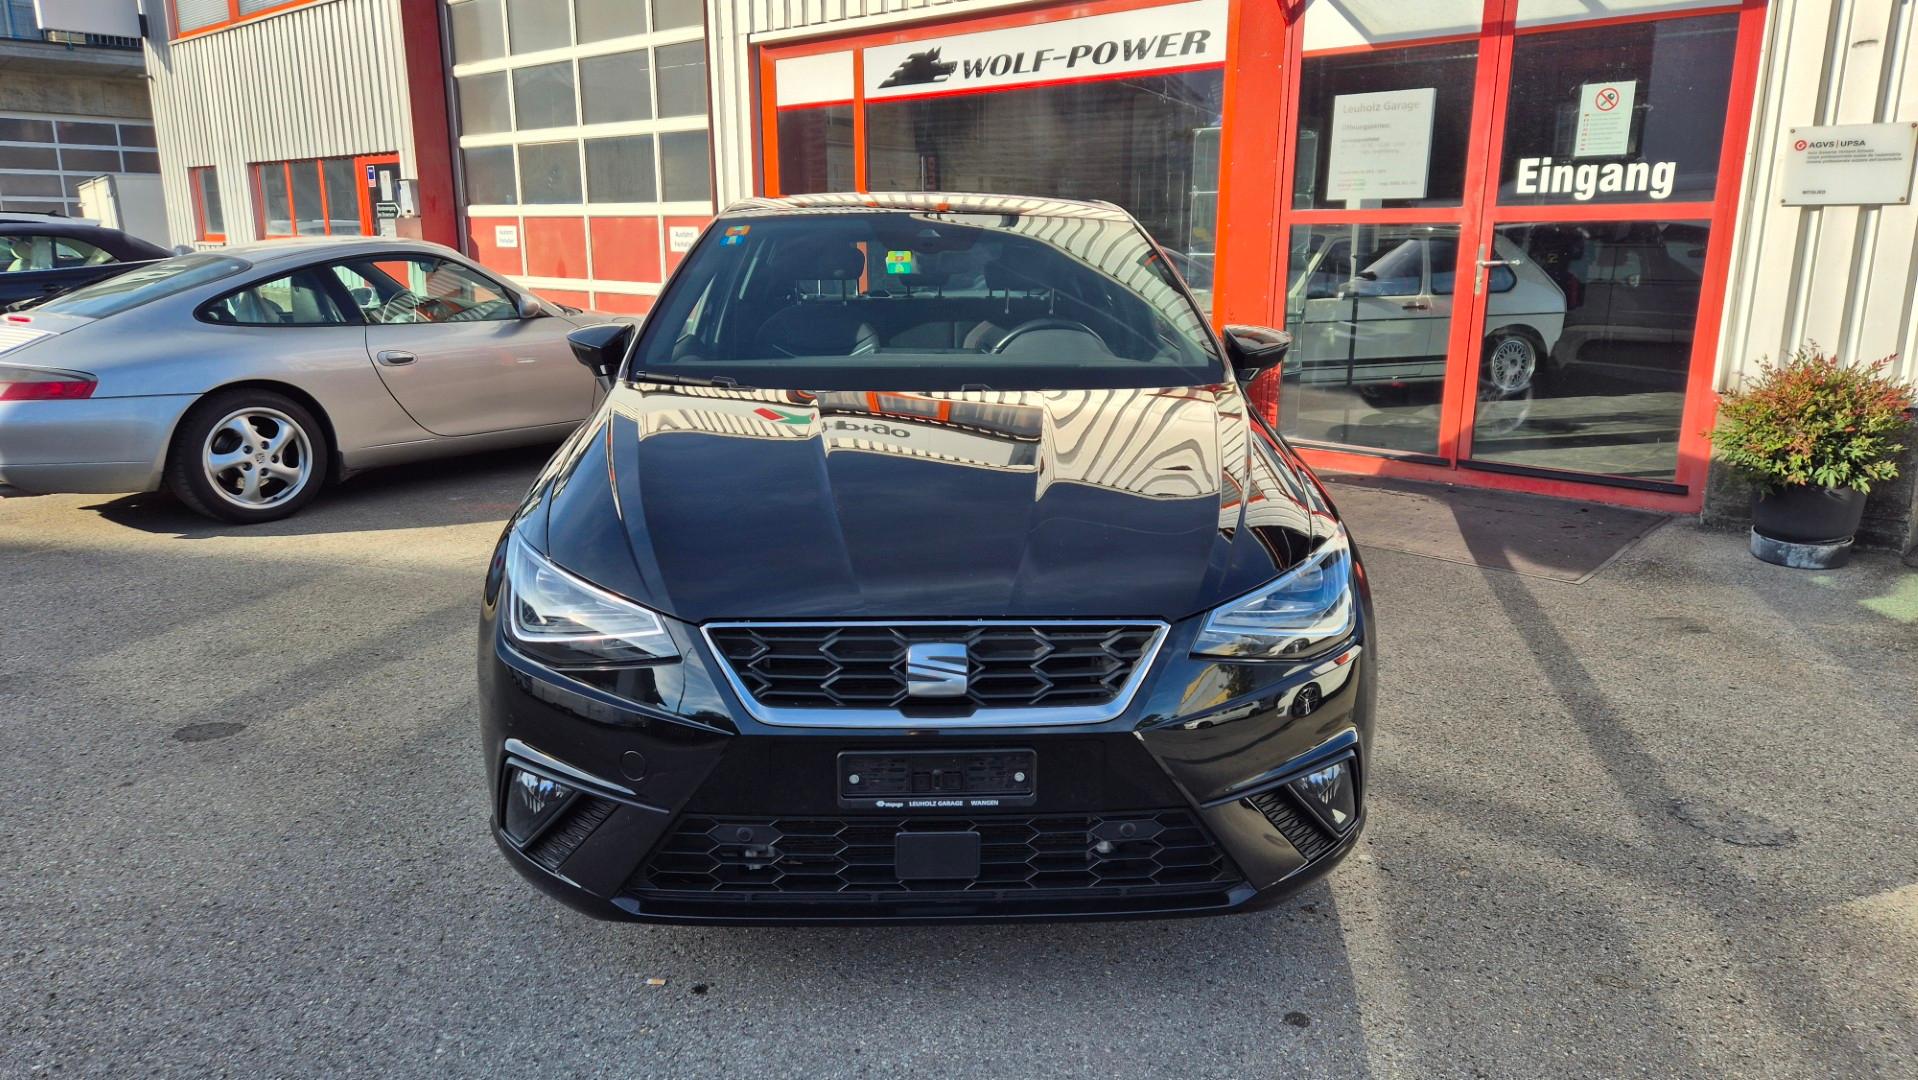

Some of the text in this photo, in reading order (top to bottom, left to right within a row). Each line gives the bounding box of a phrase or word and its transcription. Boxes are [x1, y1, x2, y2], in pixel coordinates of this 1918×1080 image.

[963, 29, 1211, 79] WOLF-POWER
[1383, 101, 1421, 112] Garage
[1809, 141, 1835, 149] AGVS
[1516, 157, 1677, 200] Eingang
